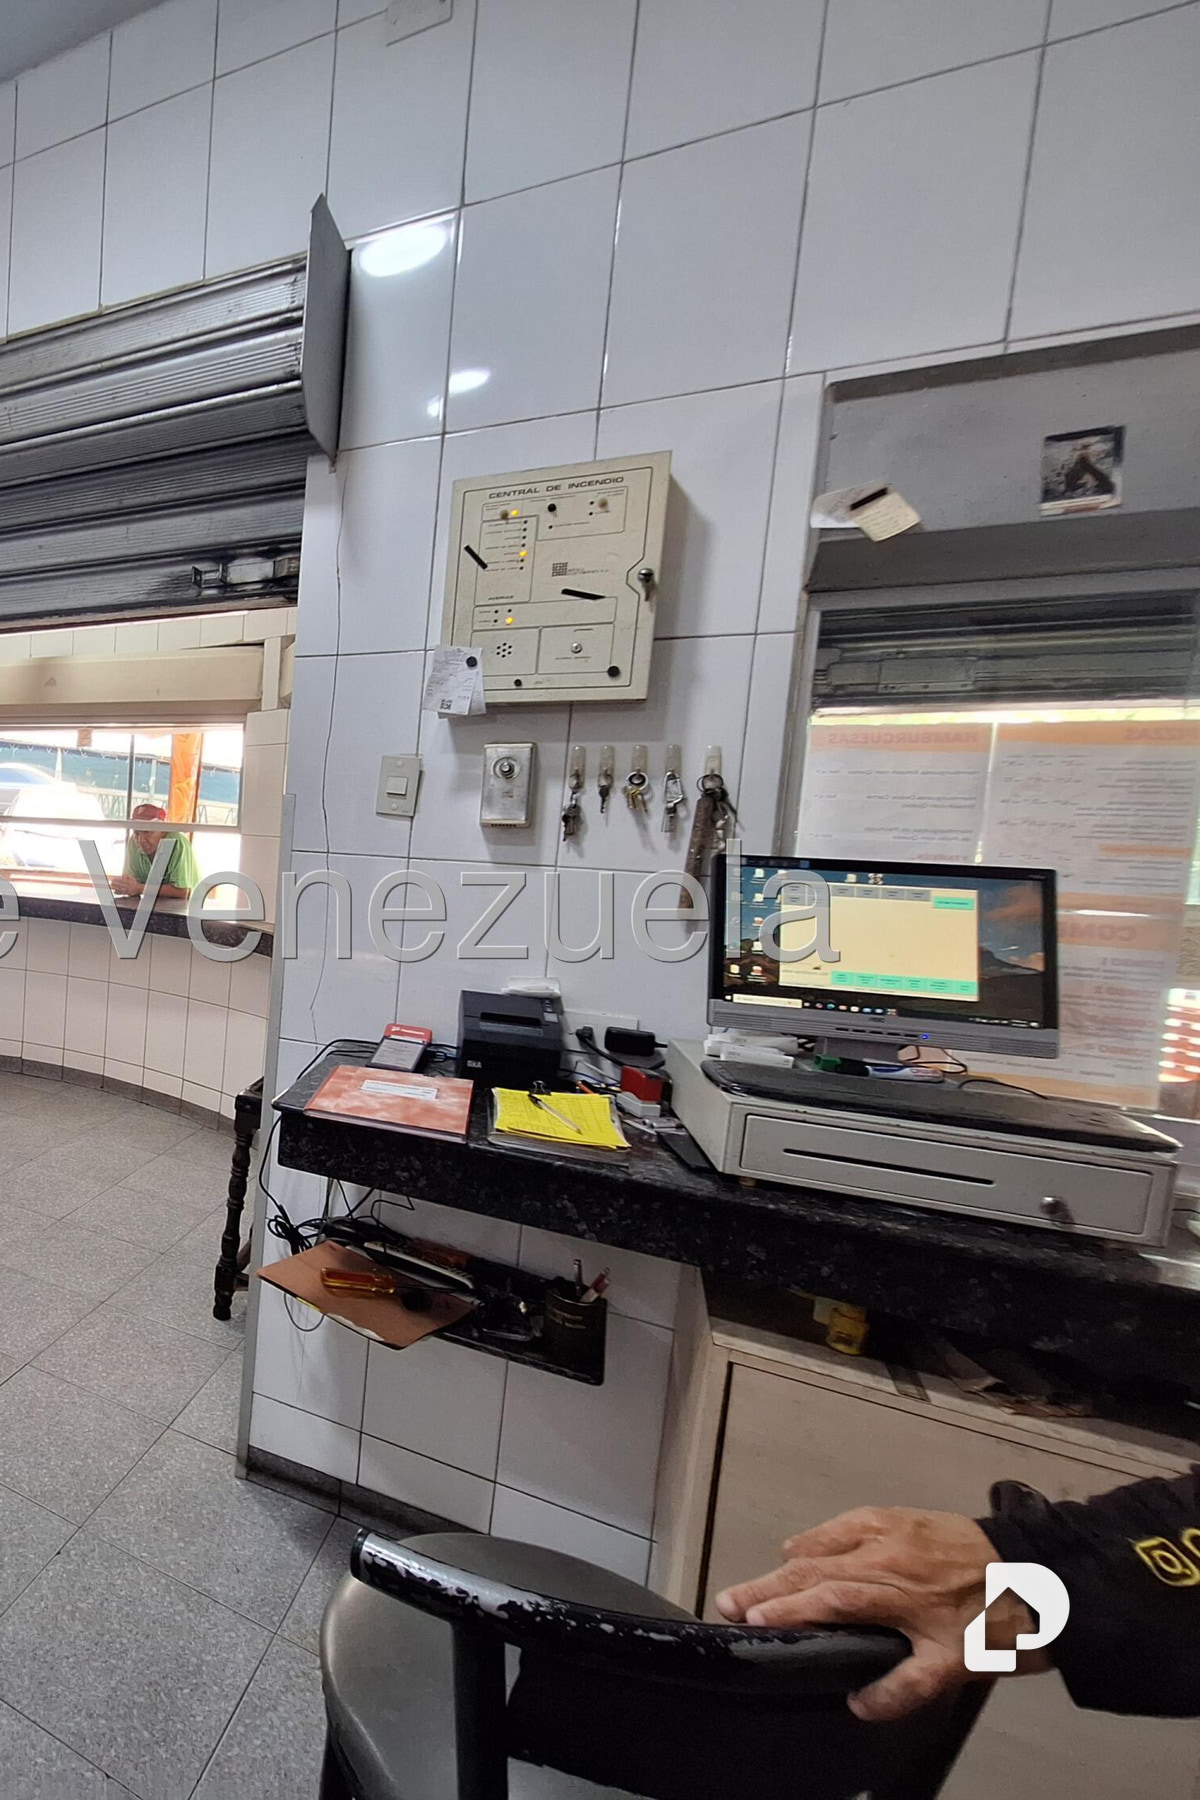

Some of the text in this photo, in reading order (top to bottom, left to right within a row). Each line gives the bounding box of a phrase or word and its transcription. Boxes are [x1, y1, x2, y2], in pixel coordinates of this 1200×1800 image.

[488, 487, 540, 499] CENTRAL
[545, 484, 562, 493] DE
[567, 476, 625, 489] INCENDIO
